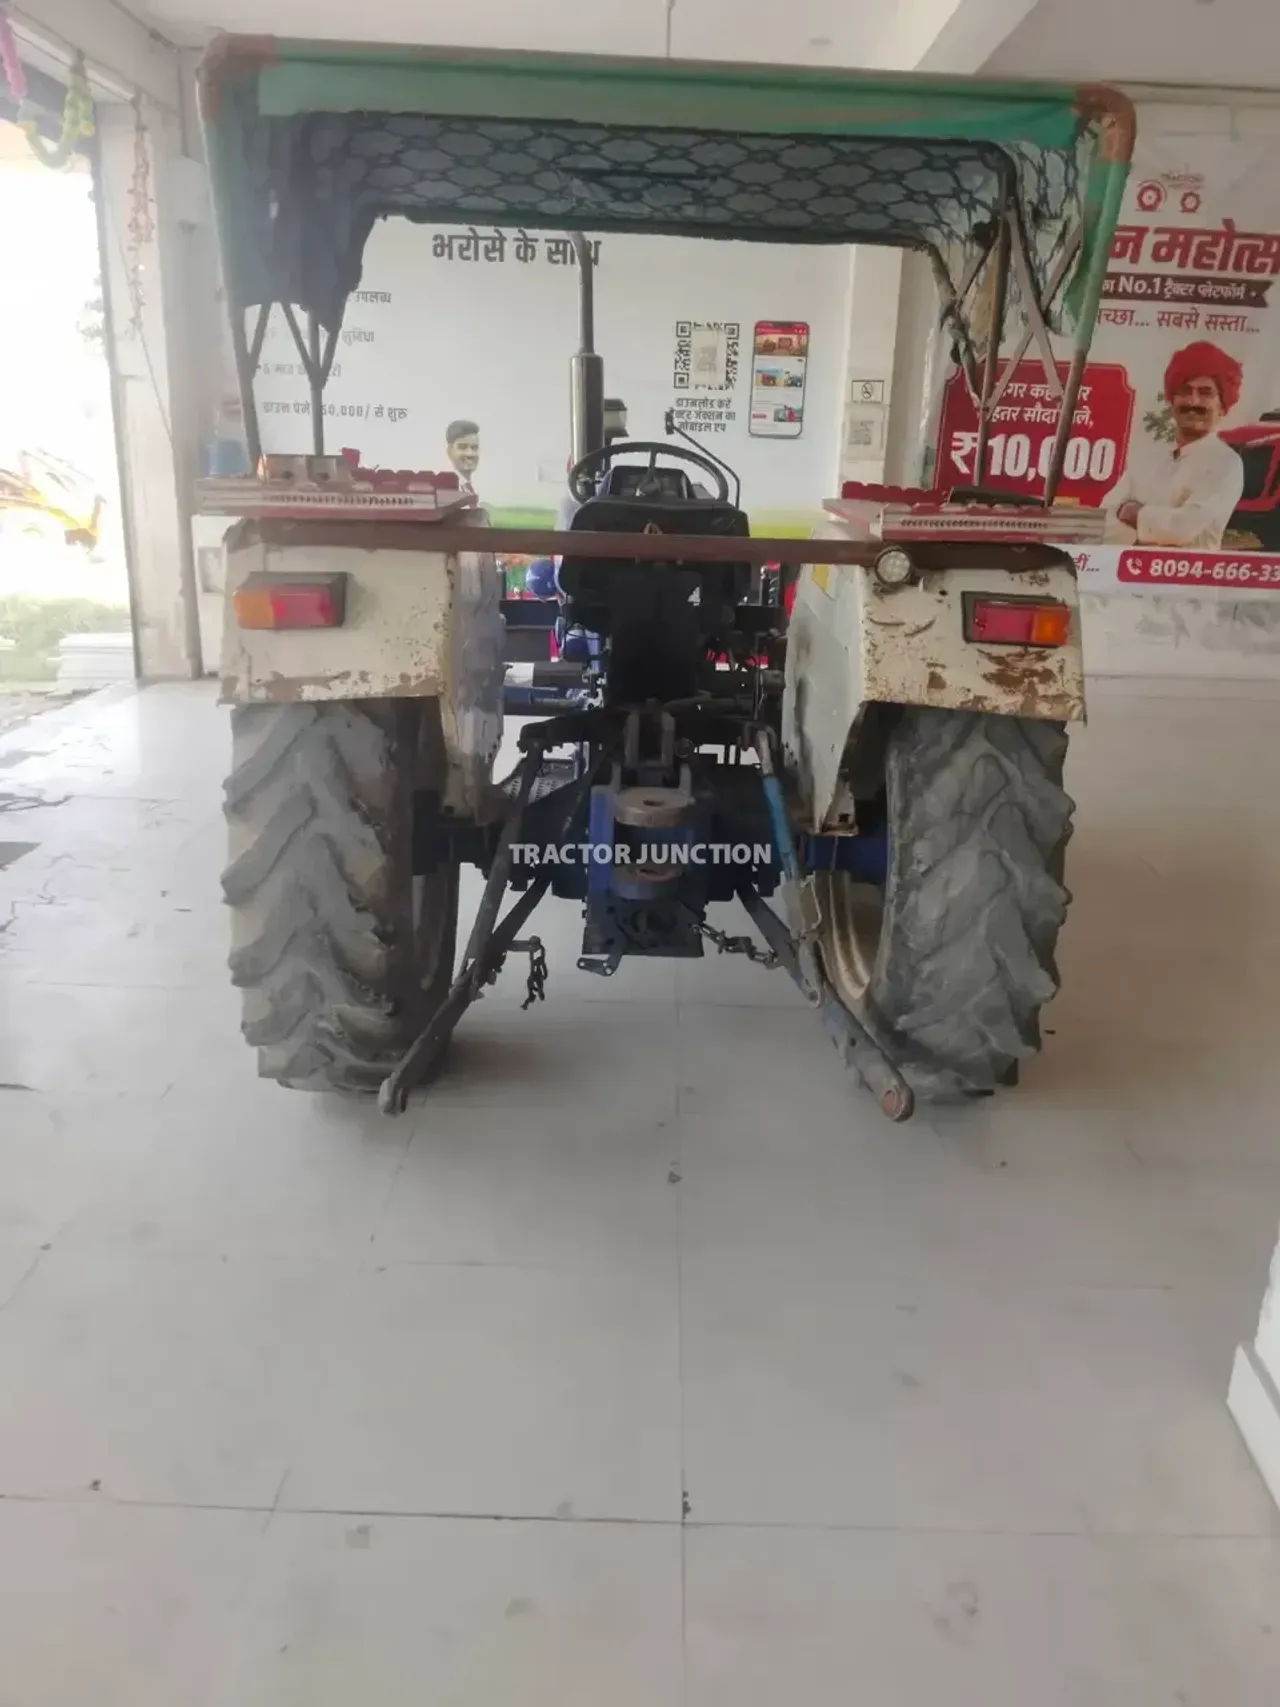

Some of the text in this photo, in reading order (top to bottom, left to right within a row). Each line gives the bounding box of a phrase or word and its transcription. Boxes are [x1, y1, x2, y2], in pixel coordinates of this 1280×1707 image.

[432, 227, 507, 262] भरोसे
[513, 229, 539, 263] के
[1151, 217, 1280, 275] महोत्स
[1118, 275, 1161, 295] No.1
[1097, 308, 1151, 327] च्छा...
[1157, 306, 1201, 330] सबसे
[997, 382, 1028, 399] गर
[1149, 558, 1280, 582] 8094-666-33
